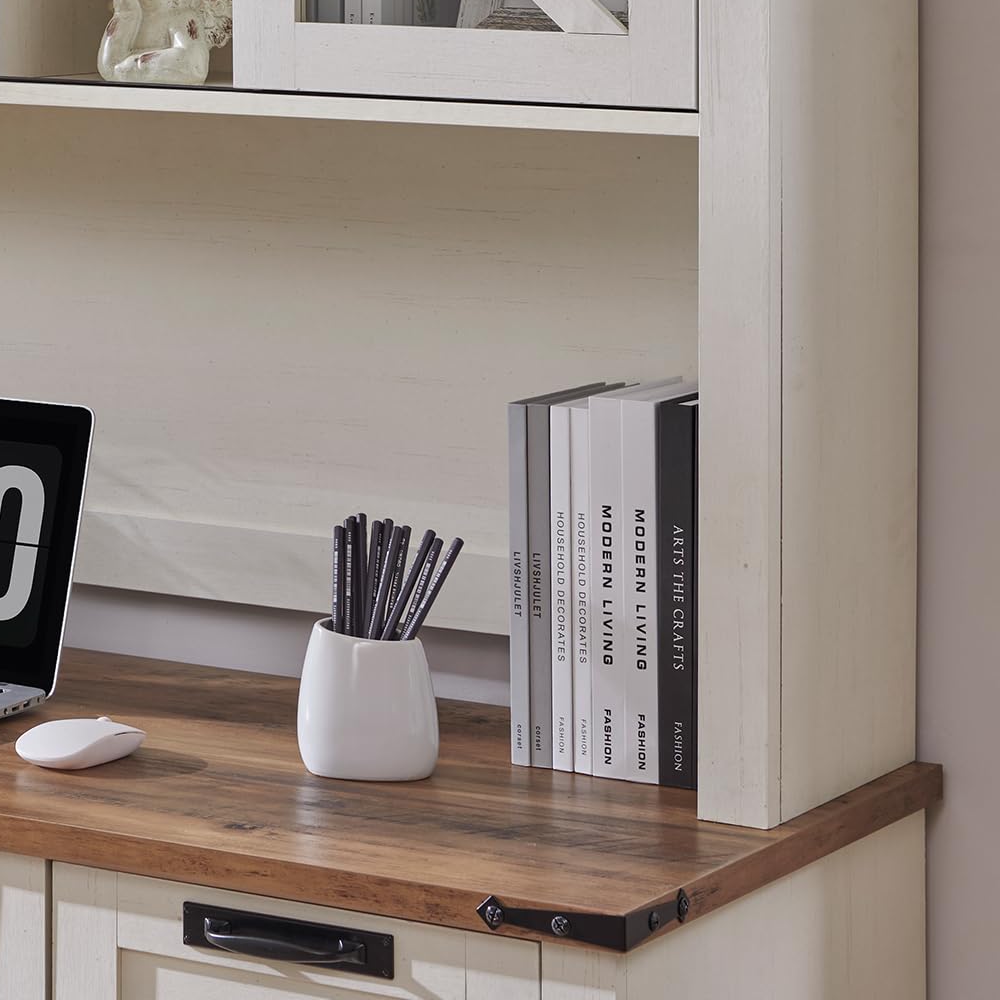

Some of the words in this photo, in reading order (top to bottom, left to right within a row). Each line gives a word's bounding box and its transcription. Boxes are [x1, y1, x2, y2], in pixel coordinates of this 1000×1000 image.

[556, 512, 565, 585] HOUSEHOLD
[577, 512, 585, 587] HOUSEHOLD
[601, 505, 612, 589] MODERN
[635, 509, 646, 593] MODERN
[672, 524, 685, 566] ARTS
[532, 553, 542, 619] LIVSHJULET
[673, 571, 685, 603] THE
[557, 590, 566, 662] DECORATES
[578, 592, 587, 664] DECORATES
[602, 599, 614, 666] LIVING
[636, 604, 647, 671] LIVING
[673, 608, 685, 671] CRAFTS
[604, 708, 612, 765] FASHION
[637, 713, 646, 771] FASHION
[674, 721, 683, 771] FASHION
